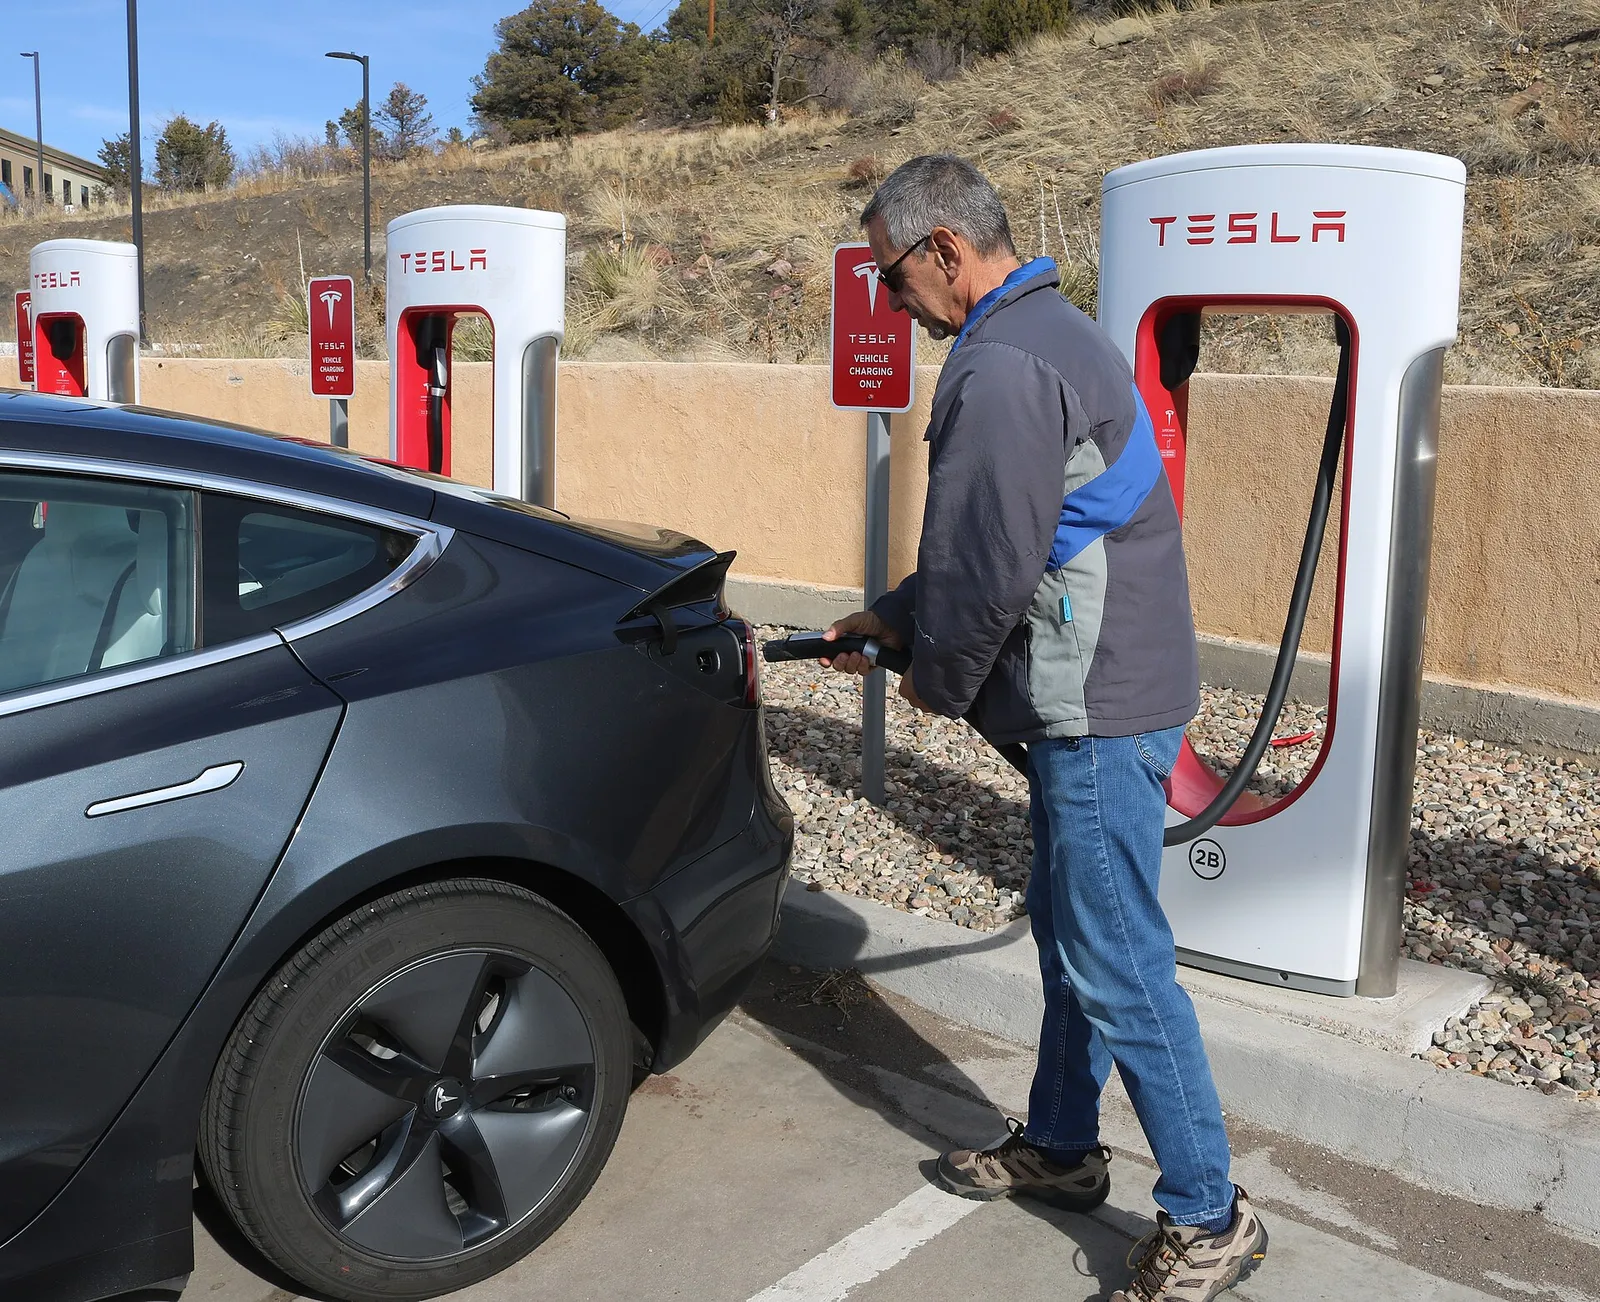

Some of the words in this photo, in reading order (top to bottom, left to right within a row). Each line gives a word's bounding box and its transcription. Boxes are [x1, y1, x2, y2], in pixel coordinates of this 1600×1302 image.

[1149, 211, 1347, 246] TESLA
[399, 249, 487, 274] TESLA
[34, 271, 81, 289] TESLA
[849, 334, 896, 344] TESLA
[319, 342, 345, 350] TESLA
[322, 356, 342, 364] VEHICLE
[854, 354, 889, 363] VEHICLE
[319, 365, 345, 373] CHARGING
[849, 366, 893, 376] CHARGING
[859, 379, 882, 389] ONLY
[1195, 849, 1220, 868] 2B
